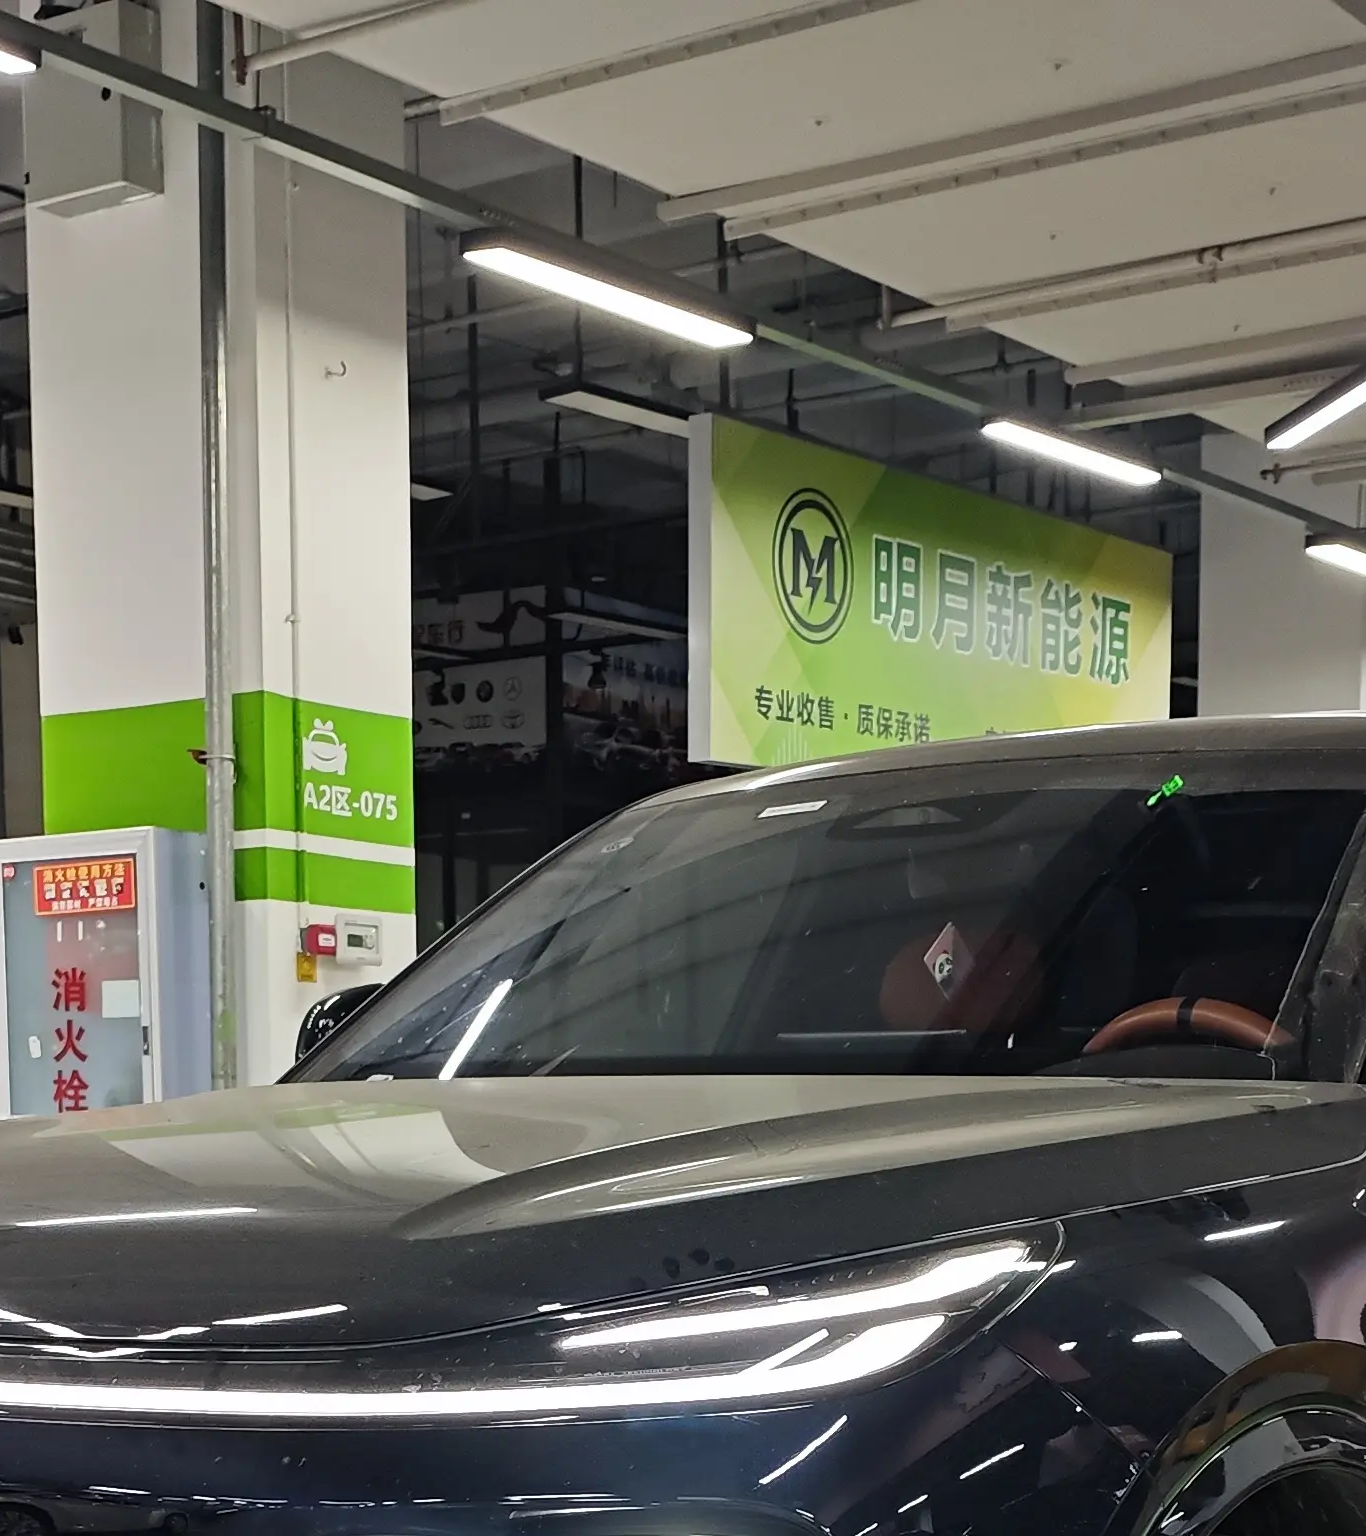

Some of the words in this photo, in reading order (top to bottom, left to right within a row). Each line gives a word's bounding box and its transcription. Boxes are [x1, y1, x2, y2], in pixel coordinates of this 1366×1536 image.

[871, 532, 1132, 686] 明月新能源
[303, 782, 398, 821] A2区-075
[51, 967, 89, 1113] 消火栓
